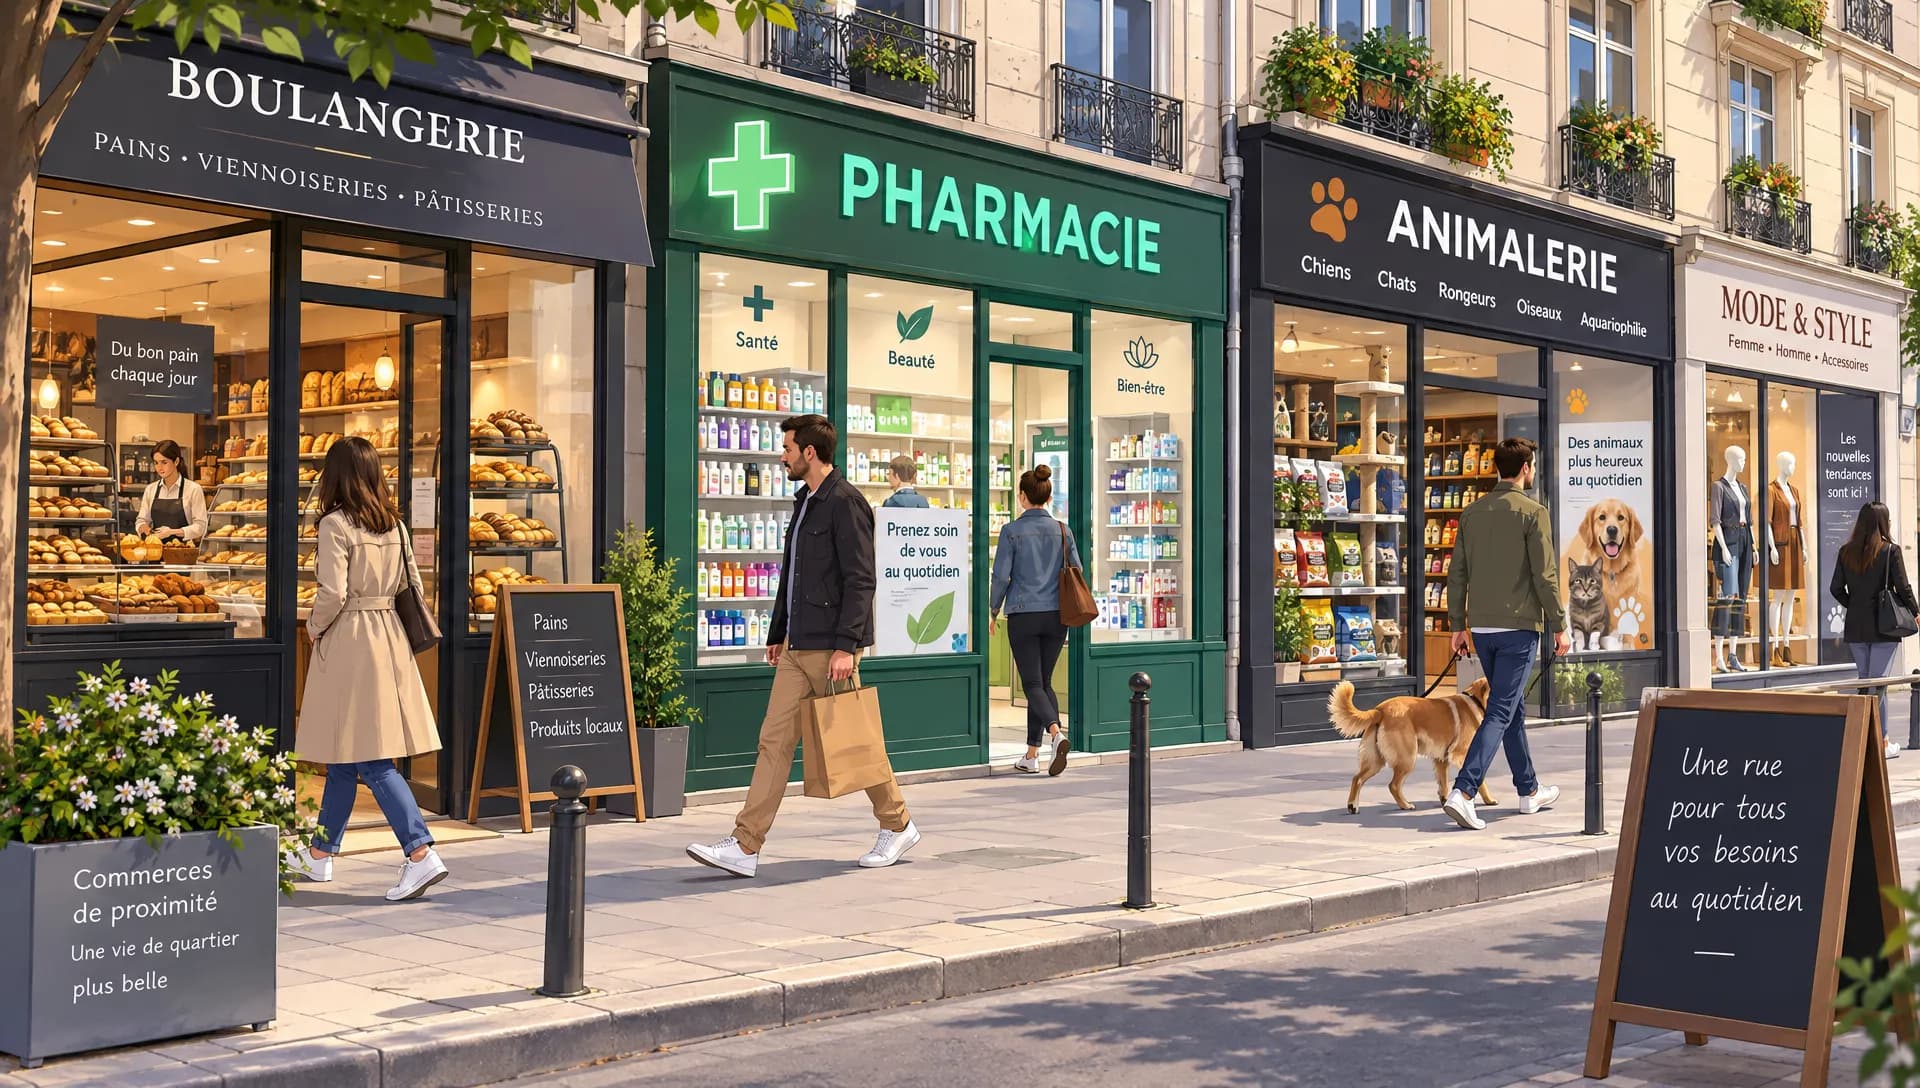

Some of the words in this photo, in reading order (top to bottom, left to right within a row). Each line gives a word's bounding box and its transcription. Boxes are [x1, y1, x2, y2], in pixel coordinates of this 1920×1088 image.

[167, 57, 526, 165] BOULANGERIE
[94, 132, 170, 163] PAINS
[198, 153, 388, 201] VIENNOISERIES
[414, 189, 543, 227] PÂTISSERIES
[842, 152, 1162, 274] PHARMACIE
[1387, 199, 1618, 295] ANIMALERIE
[1301, 254, 1352, 281] Chiens
[1377, 270, 1417, 293] Chats
[1439, 281, 1497, 308] Rongeurs
[1516, 298, 1562, 321] Oiseaux
[1580, 311, 1647, 338] Aquariophilie
[1721, 285, 1787, 331] MODE
[1794, 303, 1808, 335] &
[1814, 306, 1873, 349] STYLE
[736, 330, 779, 351] Santé
[111, 340, 132, 358] Du
[137, 342, 164, 361] bon
[168, 347, 199, 366] pain
[888, 350, 935, 369] Beauté
[1728, 333, 1765, 353] Femme
[1775, 343, 1811, 362] Homme
[1821, 351, 1869, 373] Accessoires
[110, 364, 164, 387] chaque
[167, 369, 198, 388] jour
[1568, 436, 1590, 449] Des
[1593, 436, 1643, 449] animaux
[1840, 431, 1857, 445] Les
[1568, 454, 1592, 471] plus
[1595, 454, 1644, 468] heureux
[1826, 449, 1871, 463] nouvelles
[1568, 476, 1583, 486] au
[1586, 473, 1643, 489] quotidien
[1825, 467, 1872, 481] tendances
[1827, 487, 1849, 498] sont
[1851, 485, 1862, 498] ici
[887, 521, 930, 537] Prenez
[933, 522, 958, 537] soin
[900, 542, 916, 558] de
[918, 547, 947, 558] vous
[884, 567, 900, 578] au
[903, 563, 960, 582] quotidien
[533, 613, 568, 631] Pains
[524, 650, 606, 668] Viennoiseries
[528, 681, 594, 700] Pâtisseries
[529, 719, 582, 739] Produits
[585, 716, 624, 735] locaux
[1682, 747, 1729, 776] Une
[1743, 759, 1783, 777] rue
[1667, 800, 1725, 831] pour
[1736, 794, 1787, 821] tous
[1664, 844, 1701, 864] vos
[1714, 833, 1799, 864] besoins
[74, 864, 213, 891] Commerces
[73, 902, 102, 924] de
[111, 890, 217, 928] proximité
[1650, 891, 1678, 909] au
[1691, 881, 1803, 922] quotidien
[71, 943, 105, 962] Une
[111, 940, 136, 957] vie
[142, 936, 164, 955] de
[170, 931, 240, 958] quartier
[73, 977, 114, 1005] plus
[122, 970, 168, 993] belle
